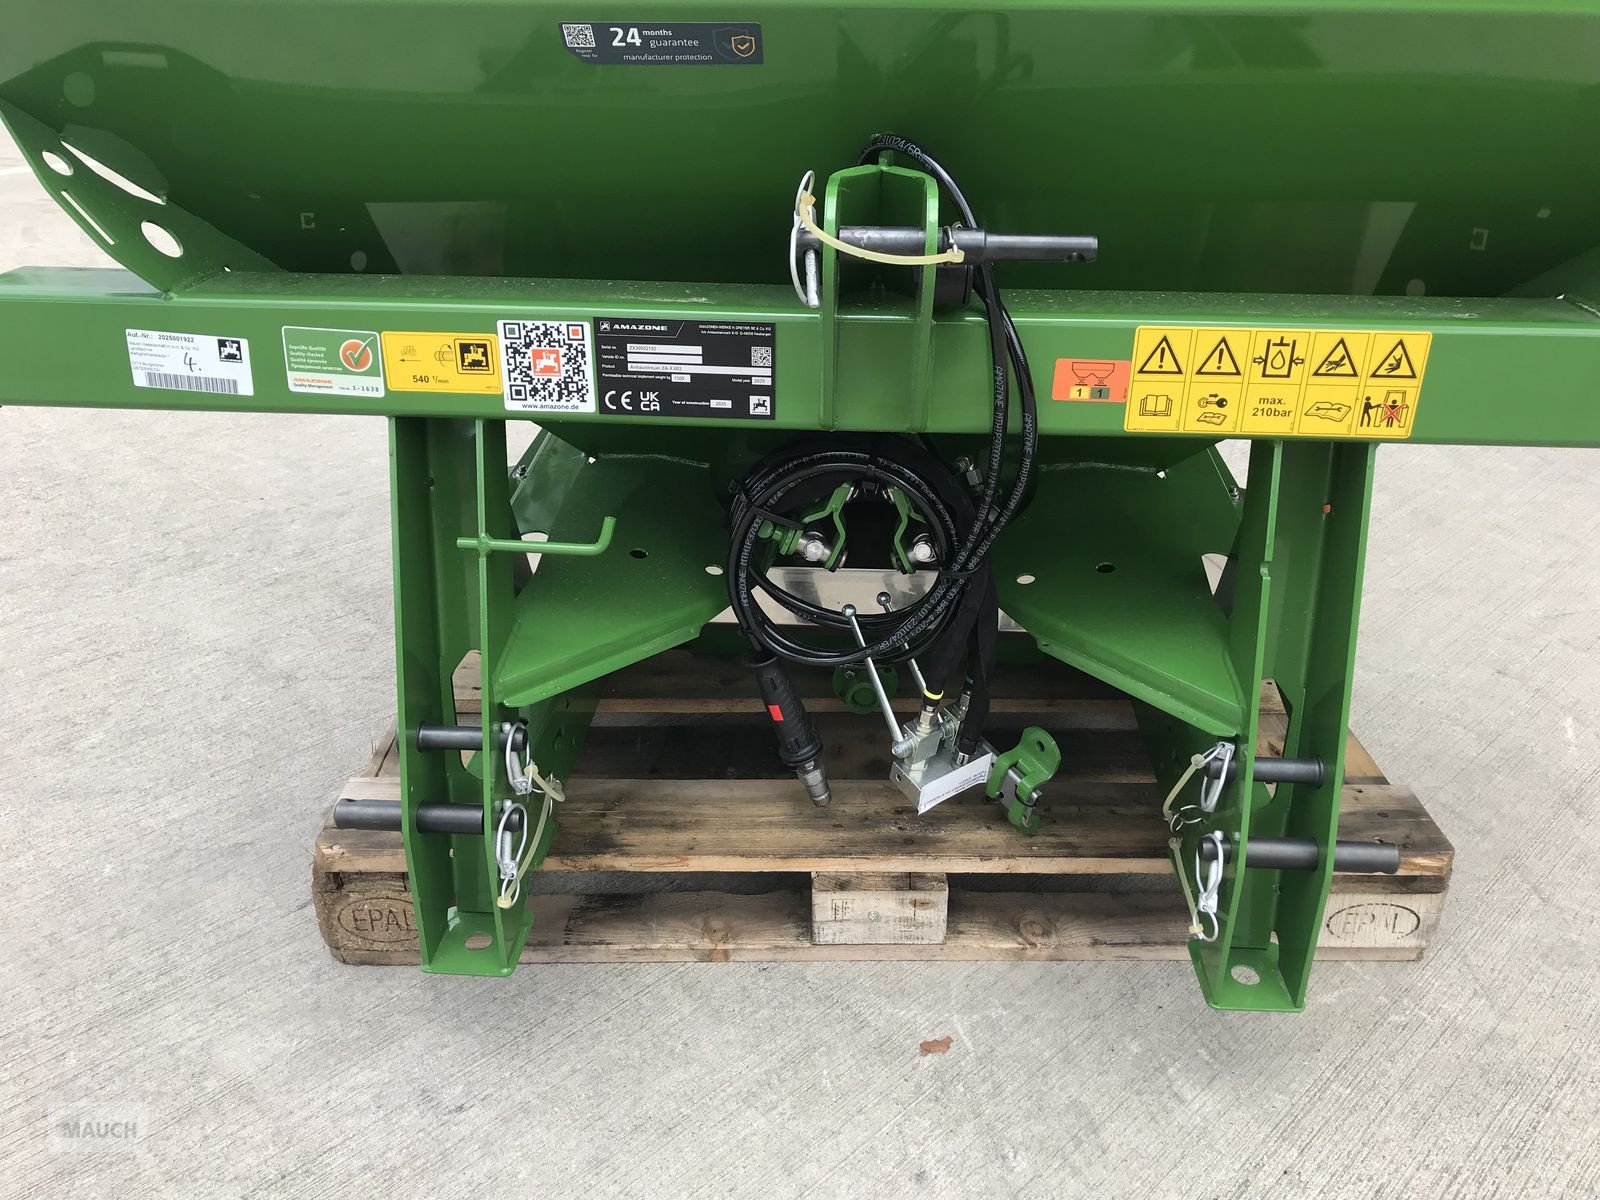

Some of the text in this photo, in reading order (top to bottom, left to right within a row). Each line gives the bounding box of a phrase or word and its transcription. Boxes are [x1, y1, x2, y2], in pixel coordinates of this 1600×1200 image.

[610, 27, 642, 46] 24
[650, 38, 699, 48] guarantee
[675, 54, 712, 62] protection
[412, 376, 430, 384] 540
[994, 366, 1003, 408] AMAZONE
[640, 392, 659, 401] UK
[1077, 388, 1102, 398] 1 1
[604, 390, 632, 410] CE
[640, 402, 660, 411] CA
[1252, 408, 1292, 417] 210bar
[1024, 413, 1032, 455] AMAZONE
[739, 570, 749, 607] AMAZONE
[352, 908, 418, 932] EPAL
